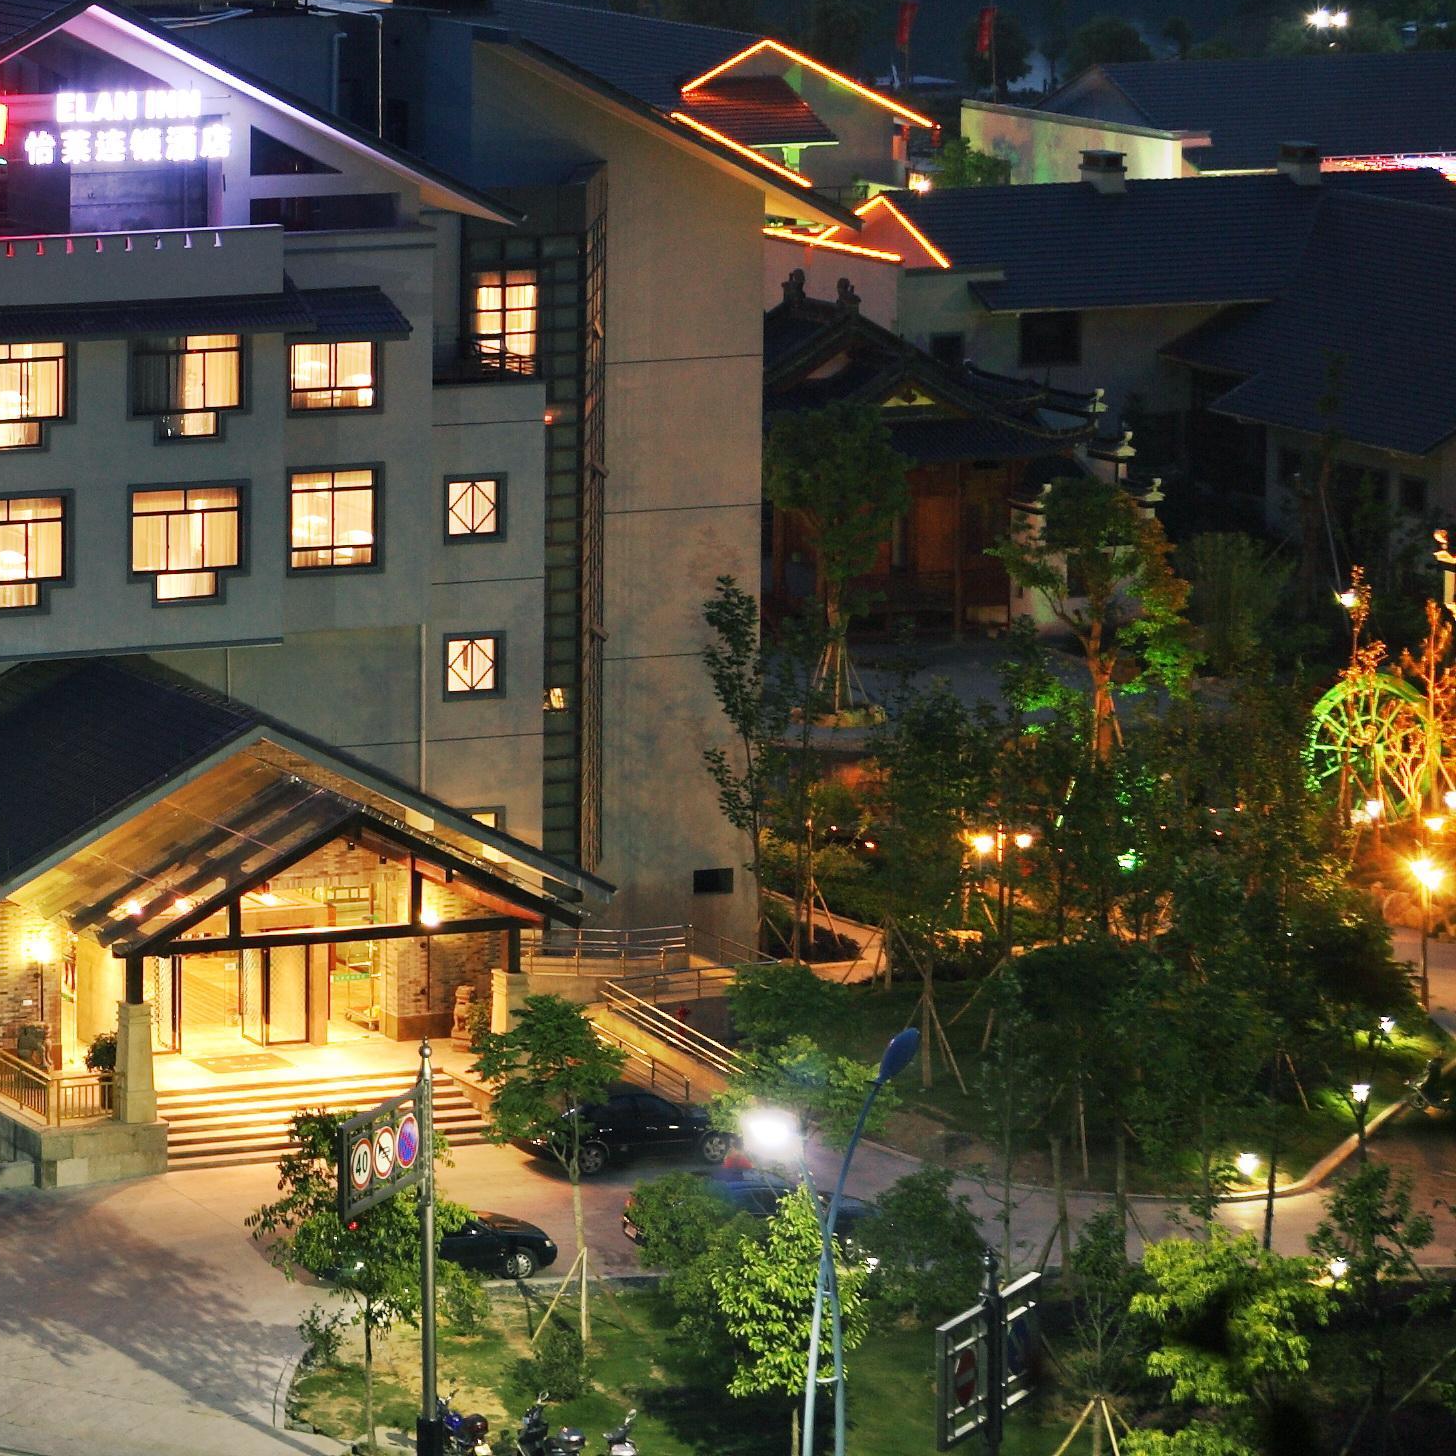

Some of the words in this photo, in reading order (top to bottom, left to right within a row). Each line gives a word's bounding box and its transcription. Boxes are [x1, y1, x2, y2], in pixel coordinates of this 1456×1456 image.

[56, 91, 137, 122] ELAN
[145, 89, 201, 119] INN
[24, 125, 231, 166] 怡莱连锁酒店
[356, 1150, 368, 1176] 40
